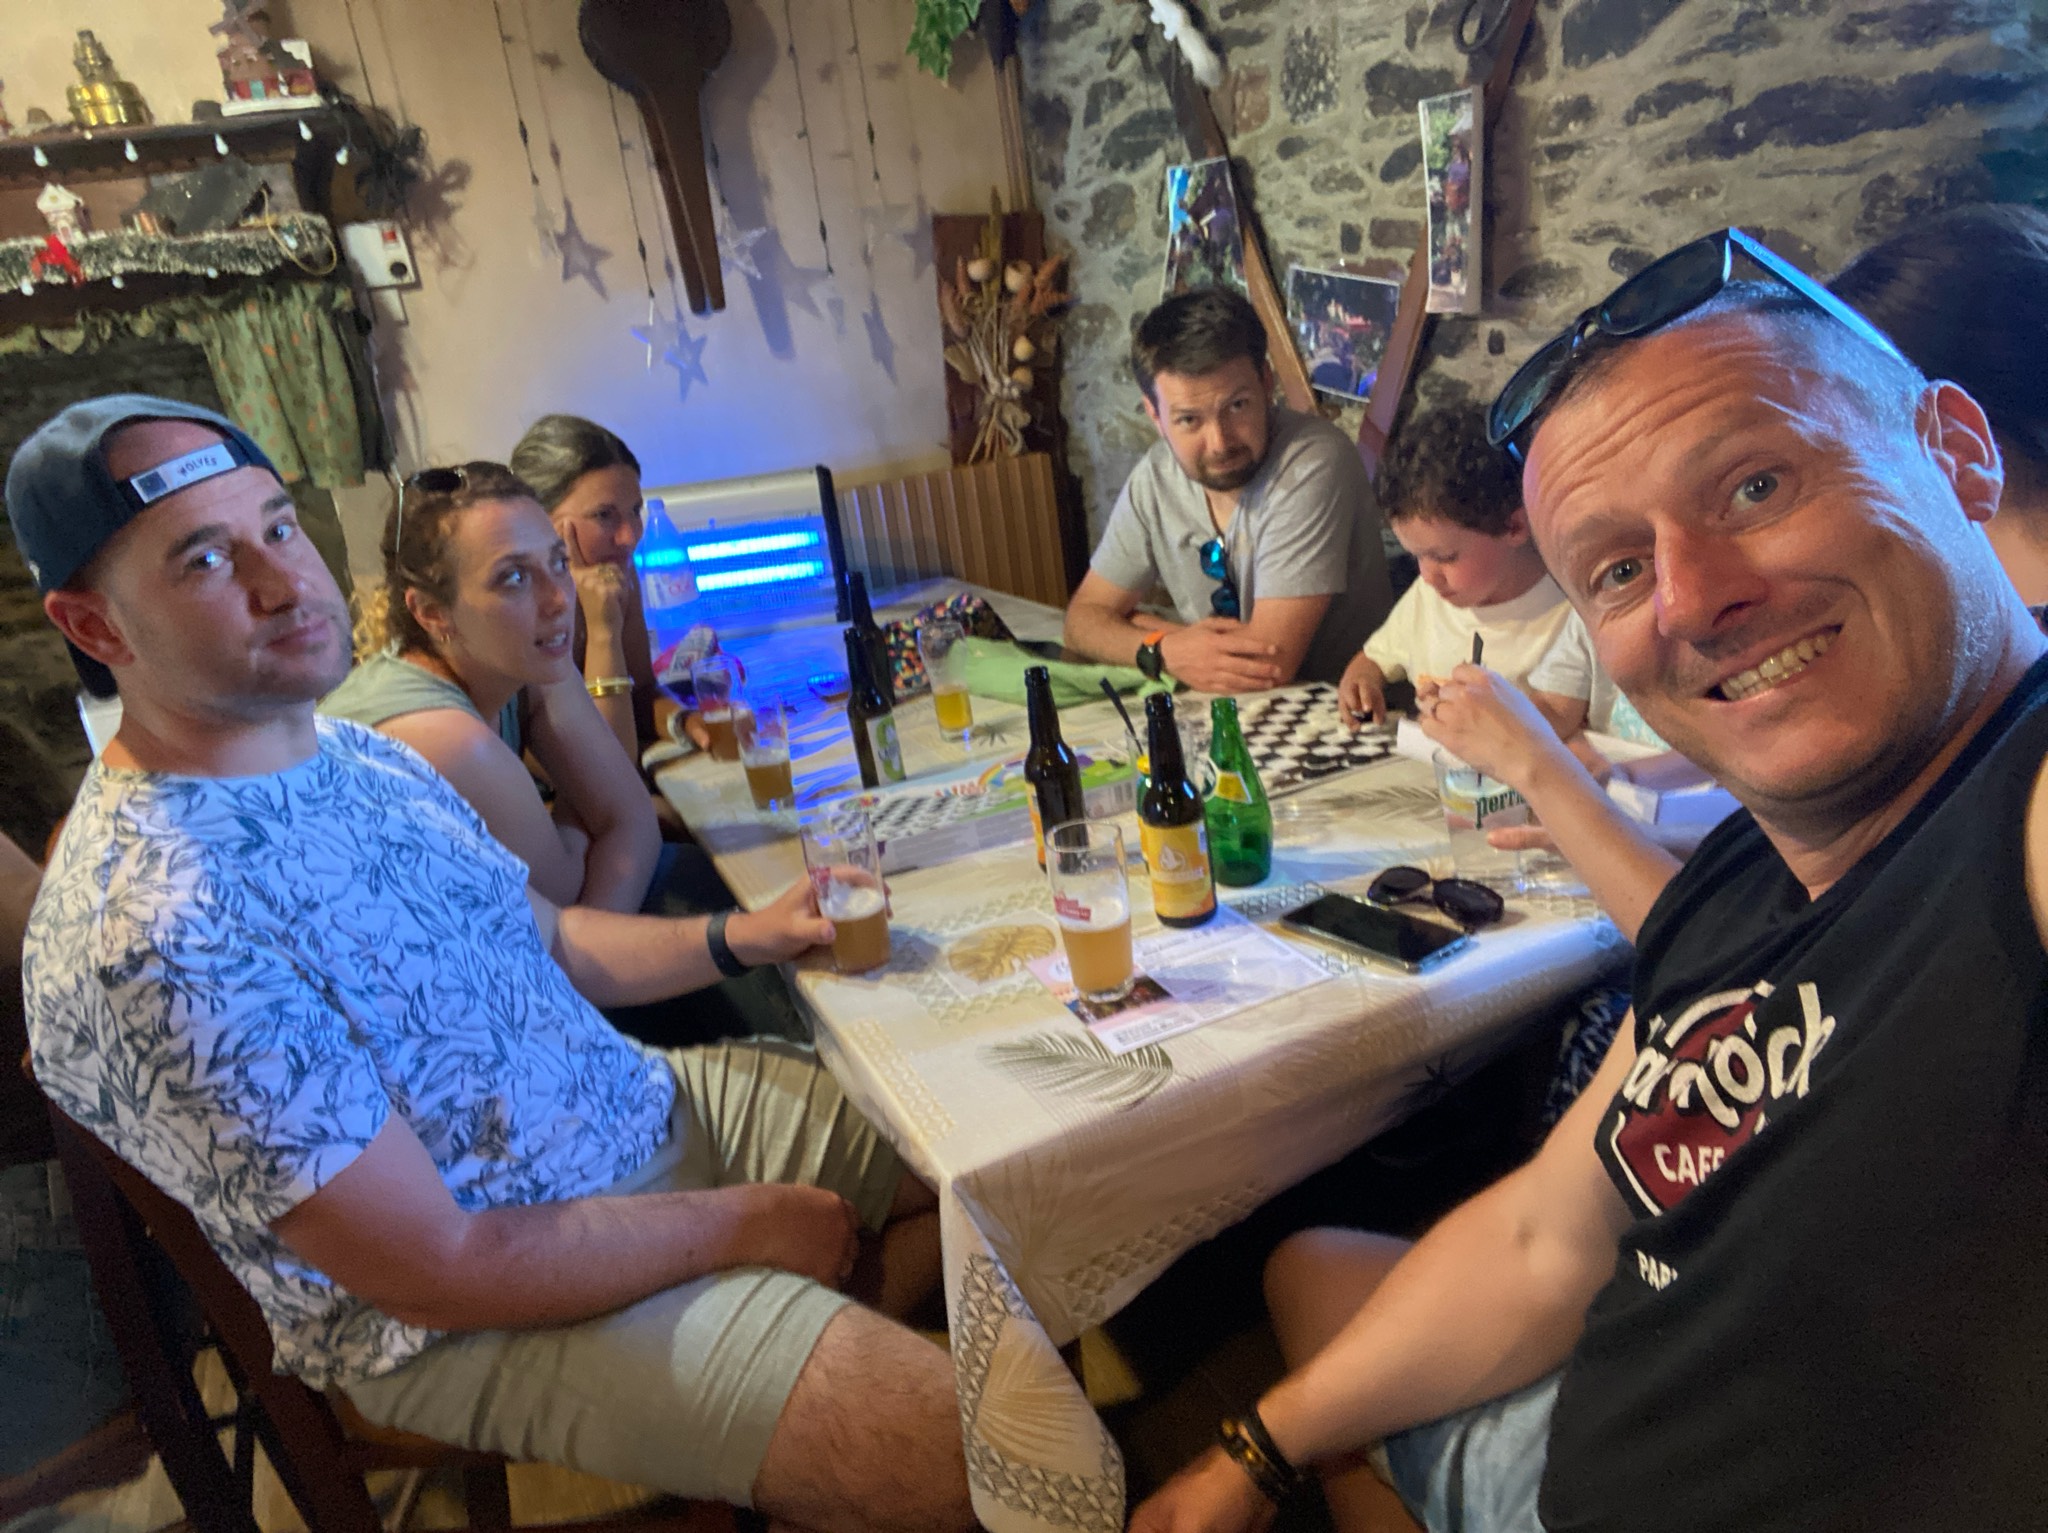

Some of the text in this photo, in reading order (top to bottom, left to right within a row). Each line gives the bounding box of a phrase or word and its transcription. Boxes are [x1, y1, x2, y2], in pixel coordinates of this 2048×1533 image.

[177, 455, 218, 477] WOLVES
[1475, 788, 1526, 831] perri
[1636, 1248, 1678, 1293] PAR
